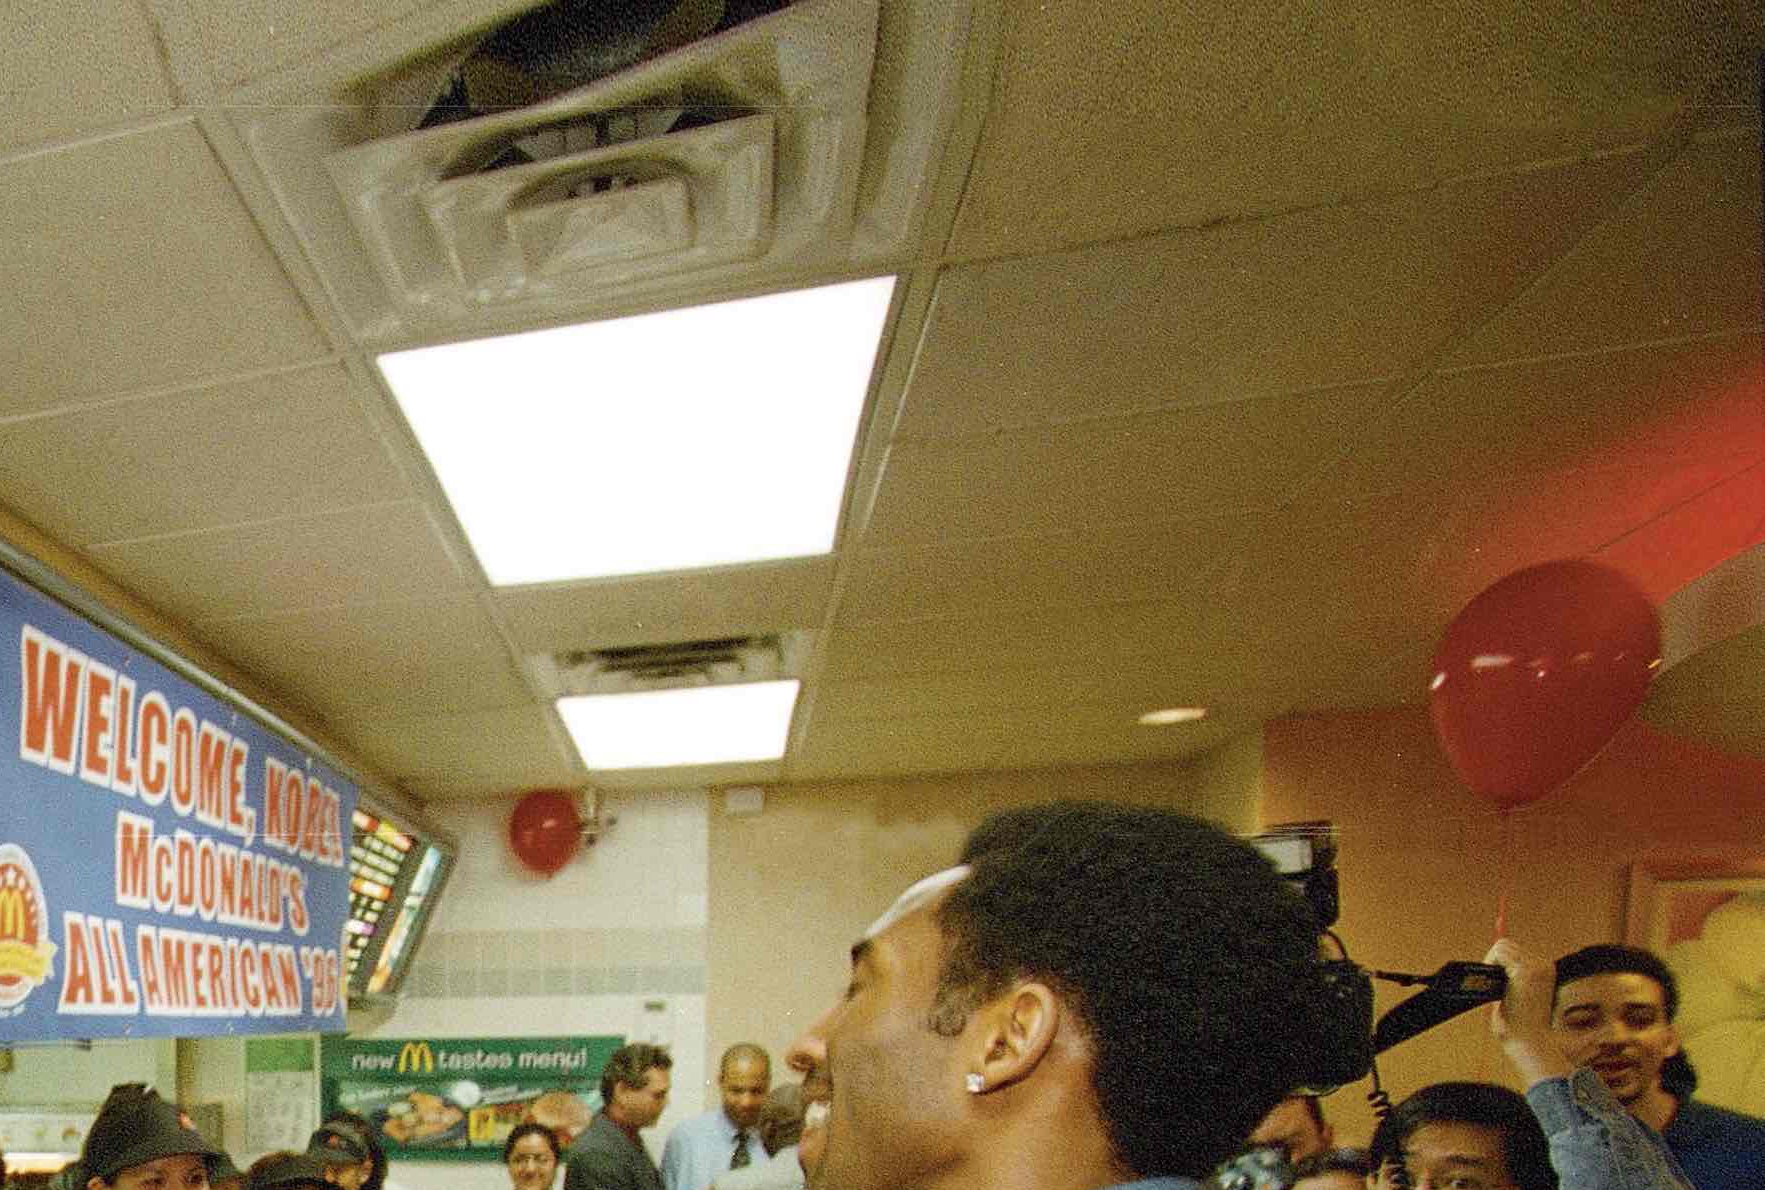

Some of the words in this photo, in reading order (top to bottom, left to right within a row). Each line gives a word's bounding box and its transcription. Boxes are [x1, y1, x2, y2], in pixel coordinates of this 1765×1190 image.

[20, 625, 256, 840] WELCOME,
[116, 811, 310, 936] McDONALD'S
[58, 912, 137, 1015] ALL
[138, 928, 302, 1018] AMERICAN
[352, 1055, 395, 1070] new
[518, 1049, 587, 1074] menu!
